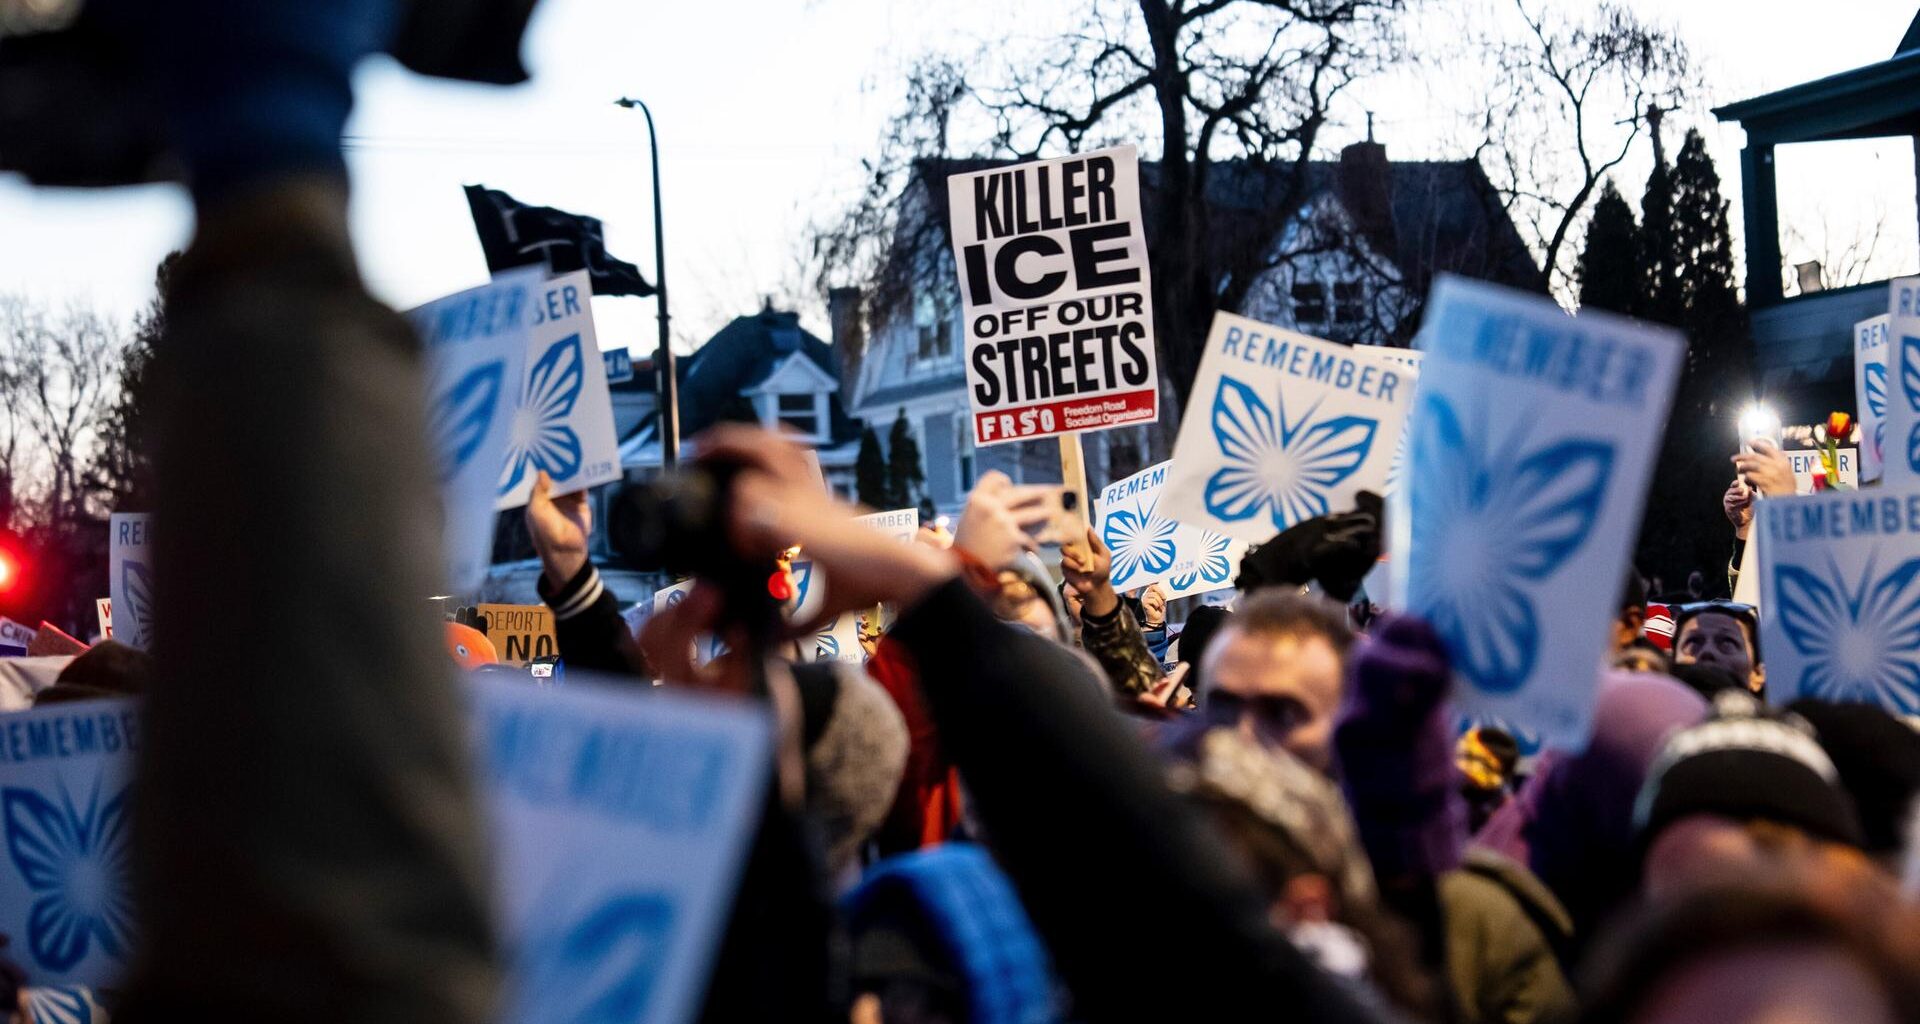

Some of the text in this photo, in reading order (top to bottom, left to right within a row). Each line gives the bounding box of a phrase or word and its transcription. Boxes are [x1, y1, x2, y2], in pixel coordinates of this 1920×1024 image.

[974, 156, 1116, 241] KILLER
[964, 222, 1141, 307] ICE
[973, 293, 1143, 338] OFF OUR
[972, 321, 1149, 407] STREETS
[1221, 326, 1399, 402] REMEMBER
[981, 409, 1056, 441] FRSO
[1063, 399, 1127, 417] Freedom Road
[1065, 413, 1103, 428] Socialist
[1788, 454, 1849, 473] EMR
[1106, 465, 1172, 506] REMEM
[863, 513, 912, 529] EMBER
[484, 611, 547, 632] DEPORT
[506, 634, 552, 661] NO
[0, 709, 137, 763] EMEMBE
